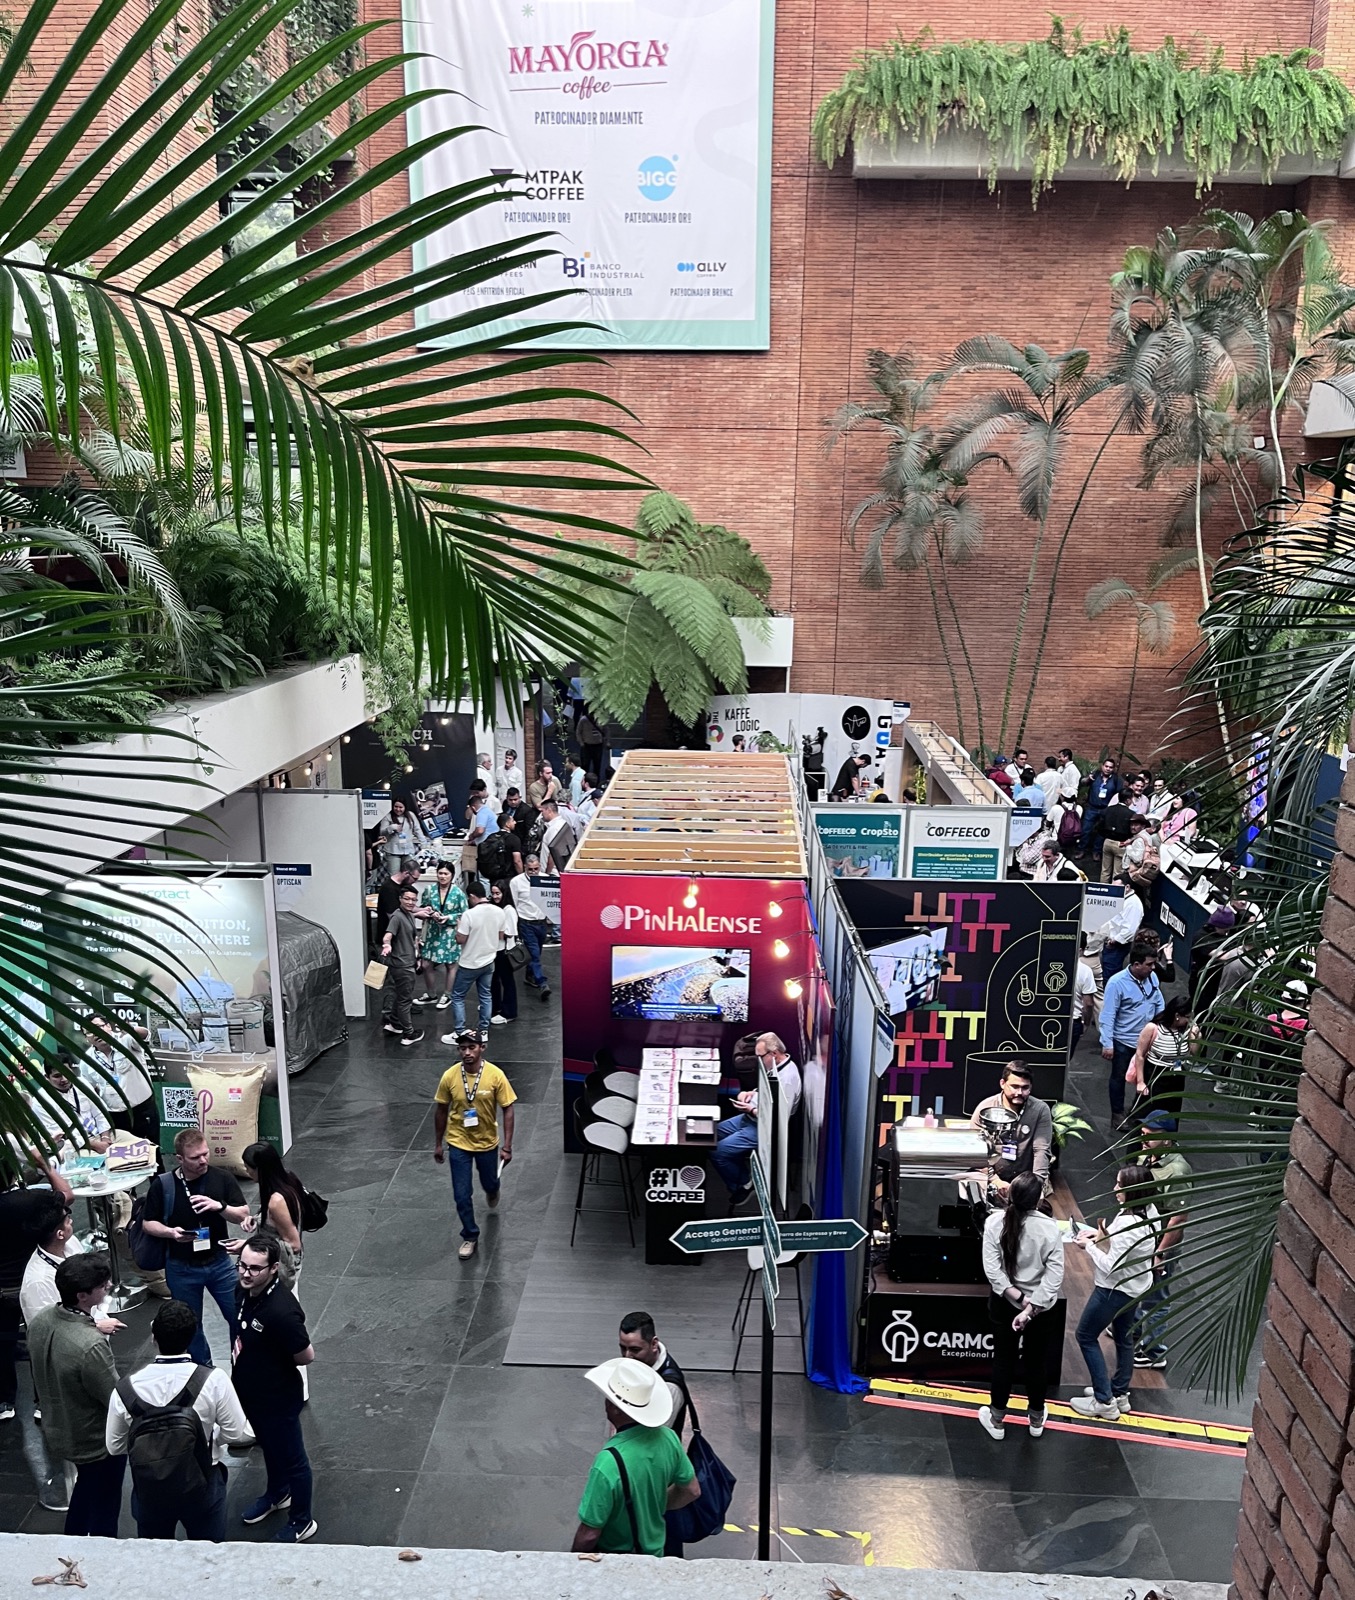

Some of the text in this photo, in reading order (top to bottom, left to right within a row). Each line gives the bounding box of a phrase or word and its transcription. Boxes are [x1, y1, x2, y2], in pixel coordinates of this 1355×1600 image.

[508, 32, 669, 74] MAYORGA
[562, 76, 613, 100] coffee
[534, 111, 643, 125] PATROCINADOR DIAMANTE
[525, 170, 584, 185] MTPAK
[637, 171, 677, 186] BIGG
[525, 187, 585, 200] COFFEE
[504, 211, 571, 223] PATROCINADOR ORO
[624, 212, 692, 223] PATROCINADOR ORO
[590, 263, 621, 271] BANCO
[590, 271, 645, 279] INDUSTRIAL
[724, 707, 751, 720] KAFFE
[735, 719, 761, 732] LOGIC
[860, 827, 899, 838] CropSto
[927, 826, 991, 838] COFFEECO
[276, 878, 302, 886] OPTISCAN
[540, 890, 561, 899] MAYORG
[546, 900, 562, 909] COFFE
[214, 1146, 227, 1154] 69
[647, 1189, 704, 1202] COFFEE
[684, 1225, 761, 1240] Acceso General
[710, 1235, 737, 1243] General
[941, 1349, 990, 1359] Exceptional
